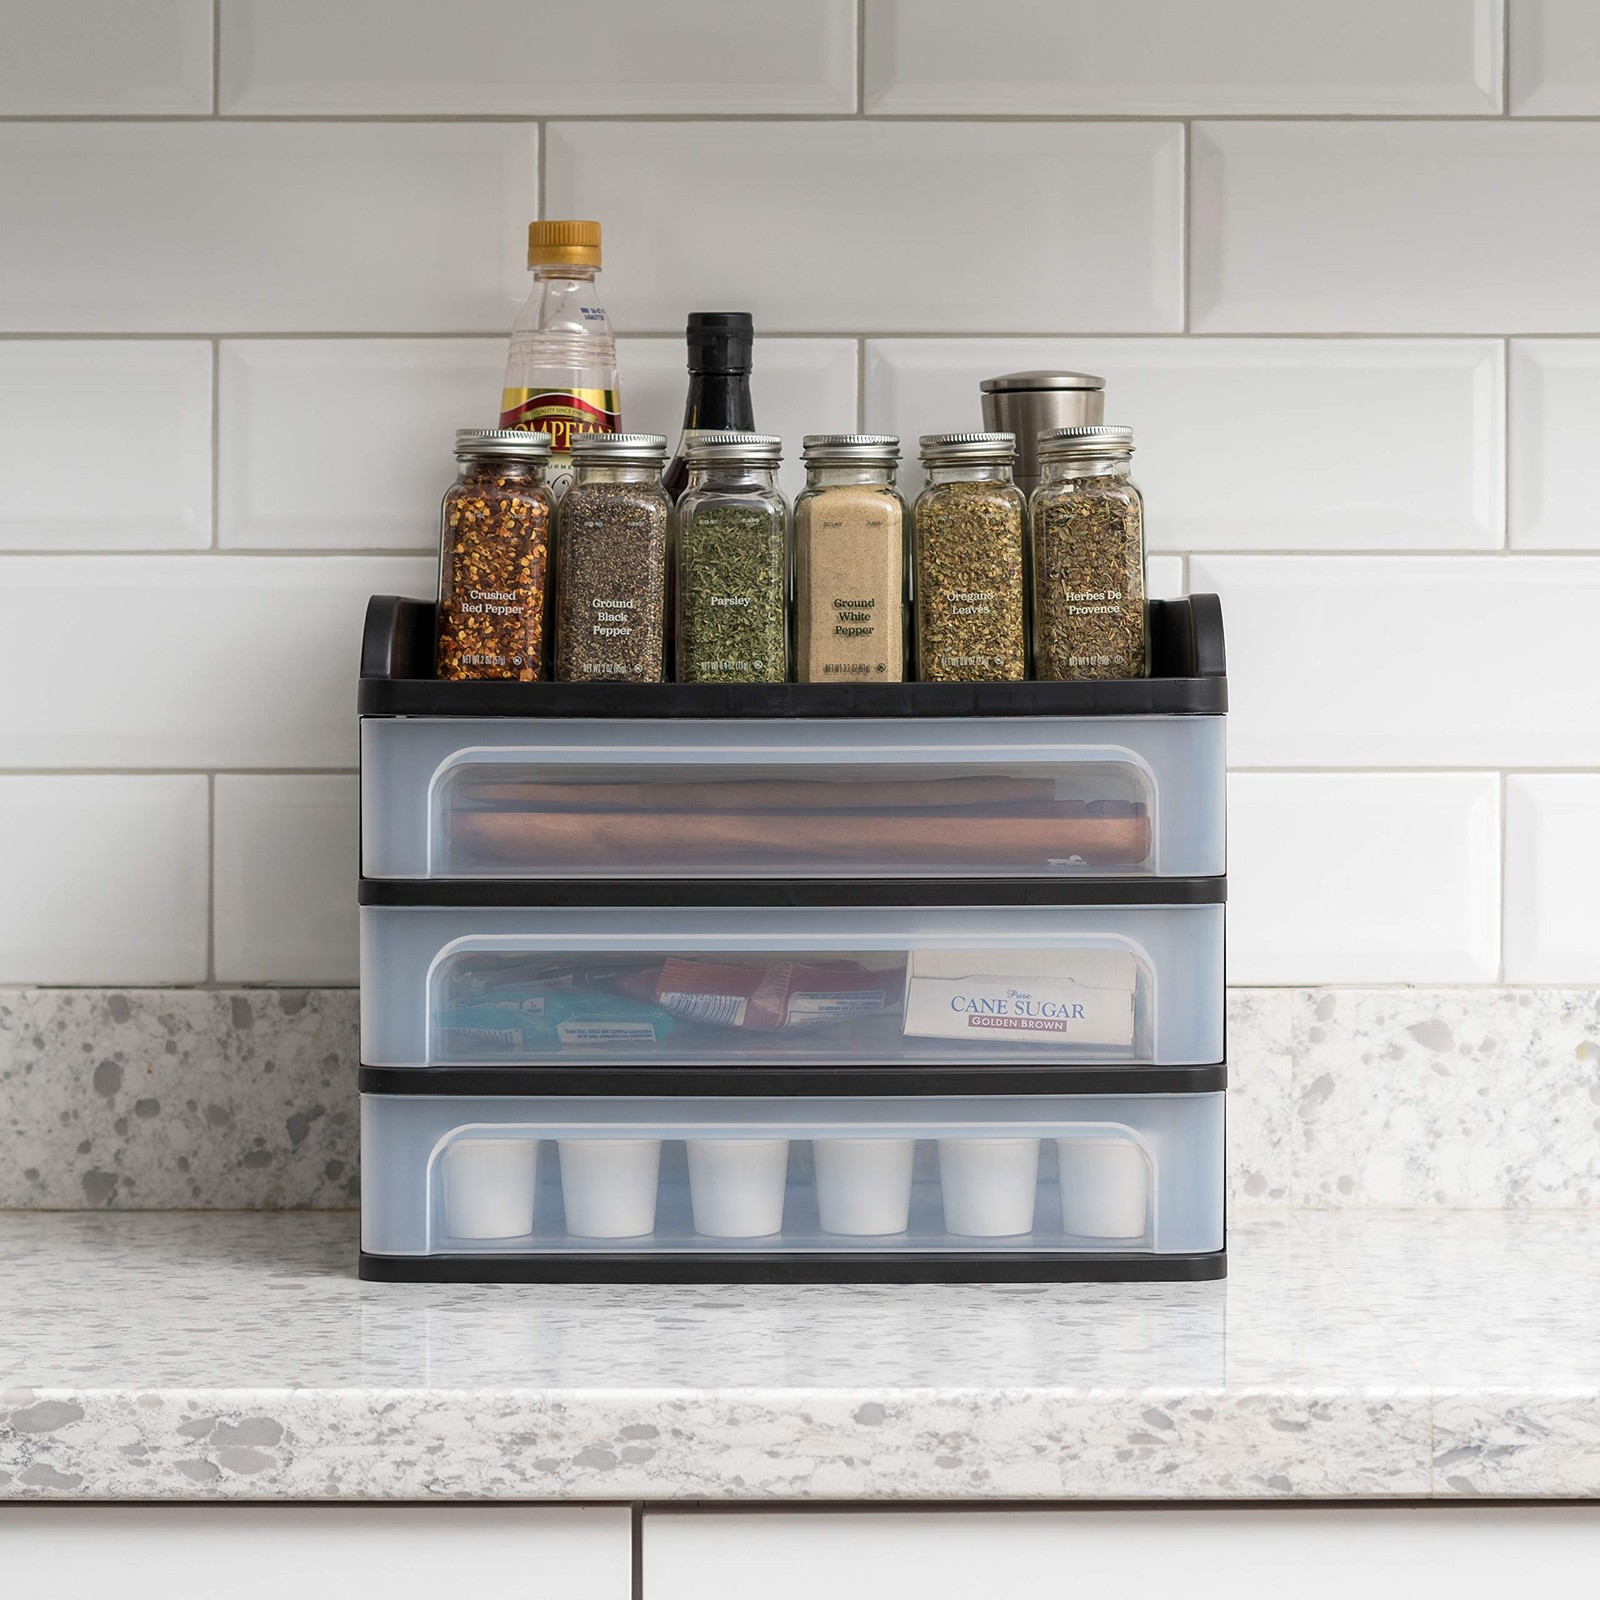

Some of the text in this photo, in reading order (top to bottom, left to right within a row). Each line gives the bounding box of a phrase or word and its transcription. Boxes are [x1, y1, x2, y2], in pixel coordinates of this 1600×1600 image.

[470, 590, 516, 600] Crushed
[947, 591, 995, 603] Oregano
[1066, 590, 1122, 601] Herbes De
[592, 599, 633, 608] Ground
[711, 596, 751, 607] Parsley
[834, 599, 875, 608] Ground
[462, 604, 524, 615] Red Pepper
[952, 606, 989, 615] Leaves
[1069, 606, 1120, 615] Provence
[598, 613, 628, 621] Black
[839, 612, 871, 621] White
[593, 626, 632, 637] Pepper
[835, 626, 874, 636] Pepper
[462, 655, 471, 664] NET
[1006, 989, 1032, 999] Pure
[951, 995, 1085, 1019] CANE SUGAR
[971, 1016, 1063, 1030] GOLDEN BROWN
